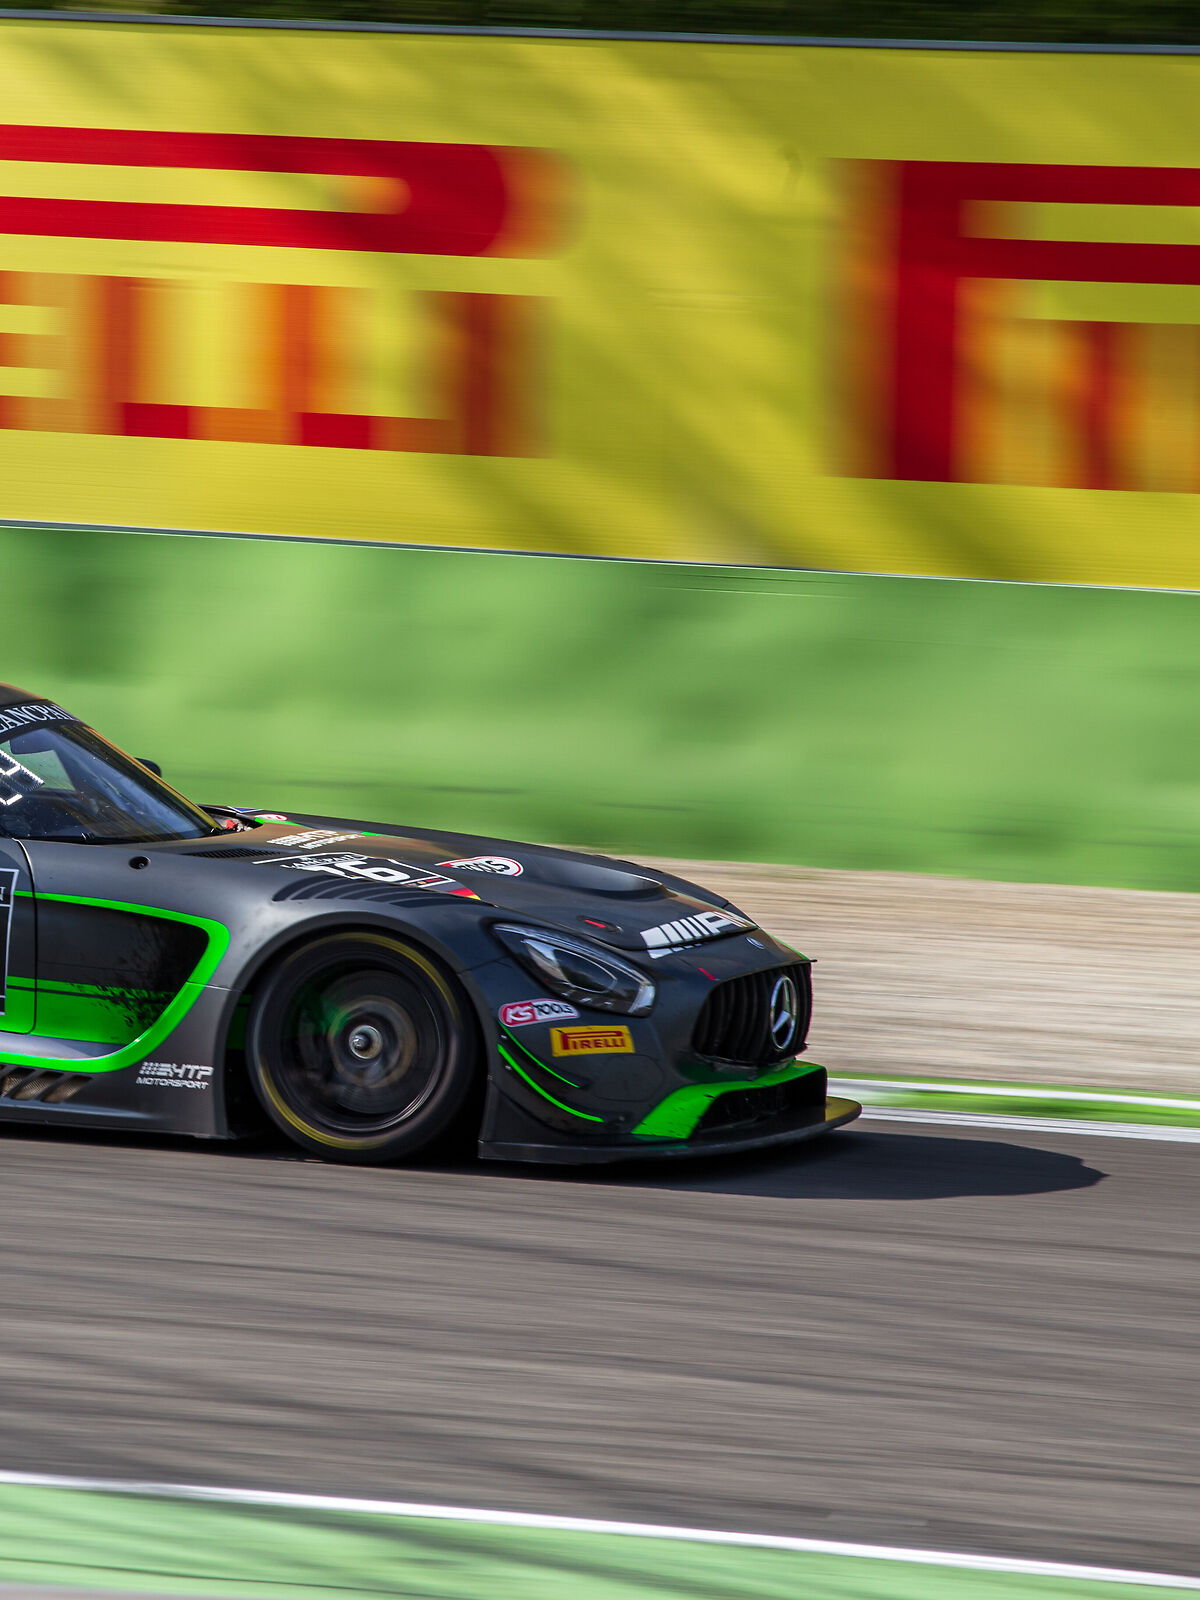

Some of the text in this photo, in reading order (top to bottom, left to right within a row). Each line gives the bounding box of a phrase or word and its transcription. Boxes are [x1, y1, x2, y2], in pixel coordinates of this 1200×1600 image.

[505, 1005, 535, 1024] KS
[561, 1030, 627, 1051] PIRELLI
[135, 1076, 210, 1090] MOTORSPORT
